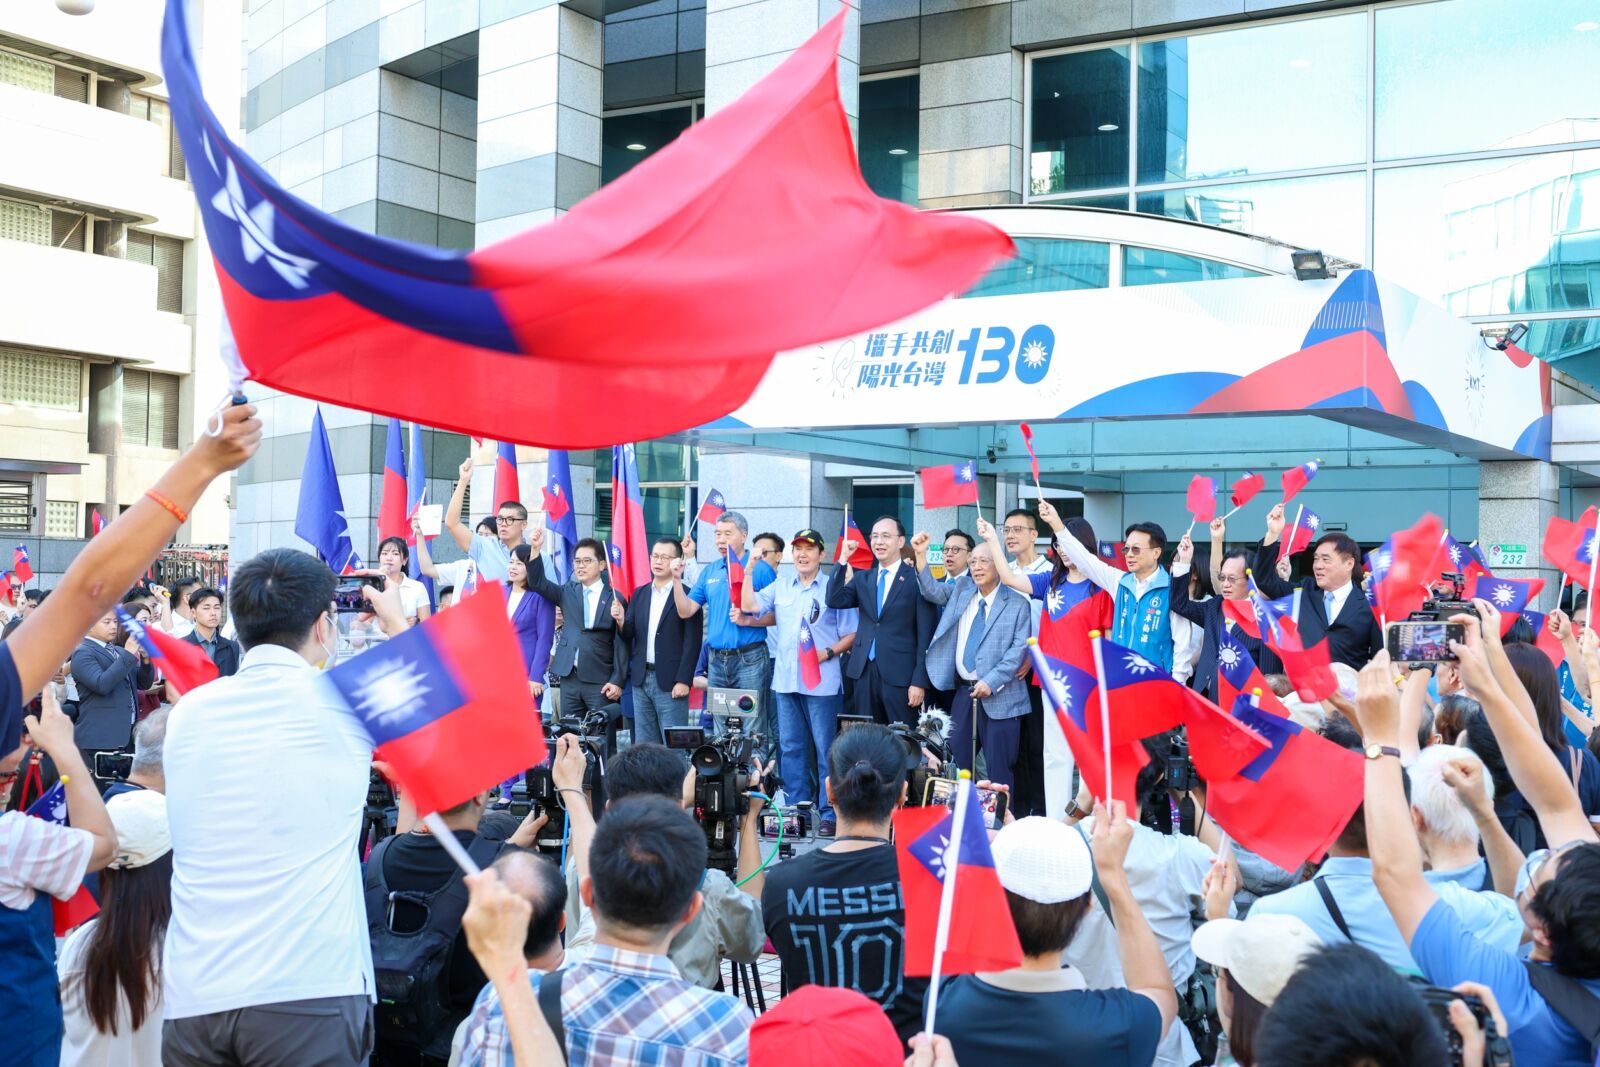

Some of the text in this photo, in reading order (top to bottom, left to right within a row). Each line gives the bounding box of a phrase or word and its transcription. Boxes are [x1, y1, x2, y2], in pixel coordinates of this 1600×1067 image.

[865, 329, 954, 357] 攜手共創
[957, 324, 1055, 385] 130
[857, 361, 946, 388] 陽光台灣
[930, 553, 944, 561] 23
[1502, 554, 1523, 565] 232
[1151, 597, 1160, 607] 6
[789, 917, 904, 1010] 10
